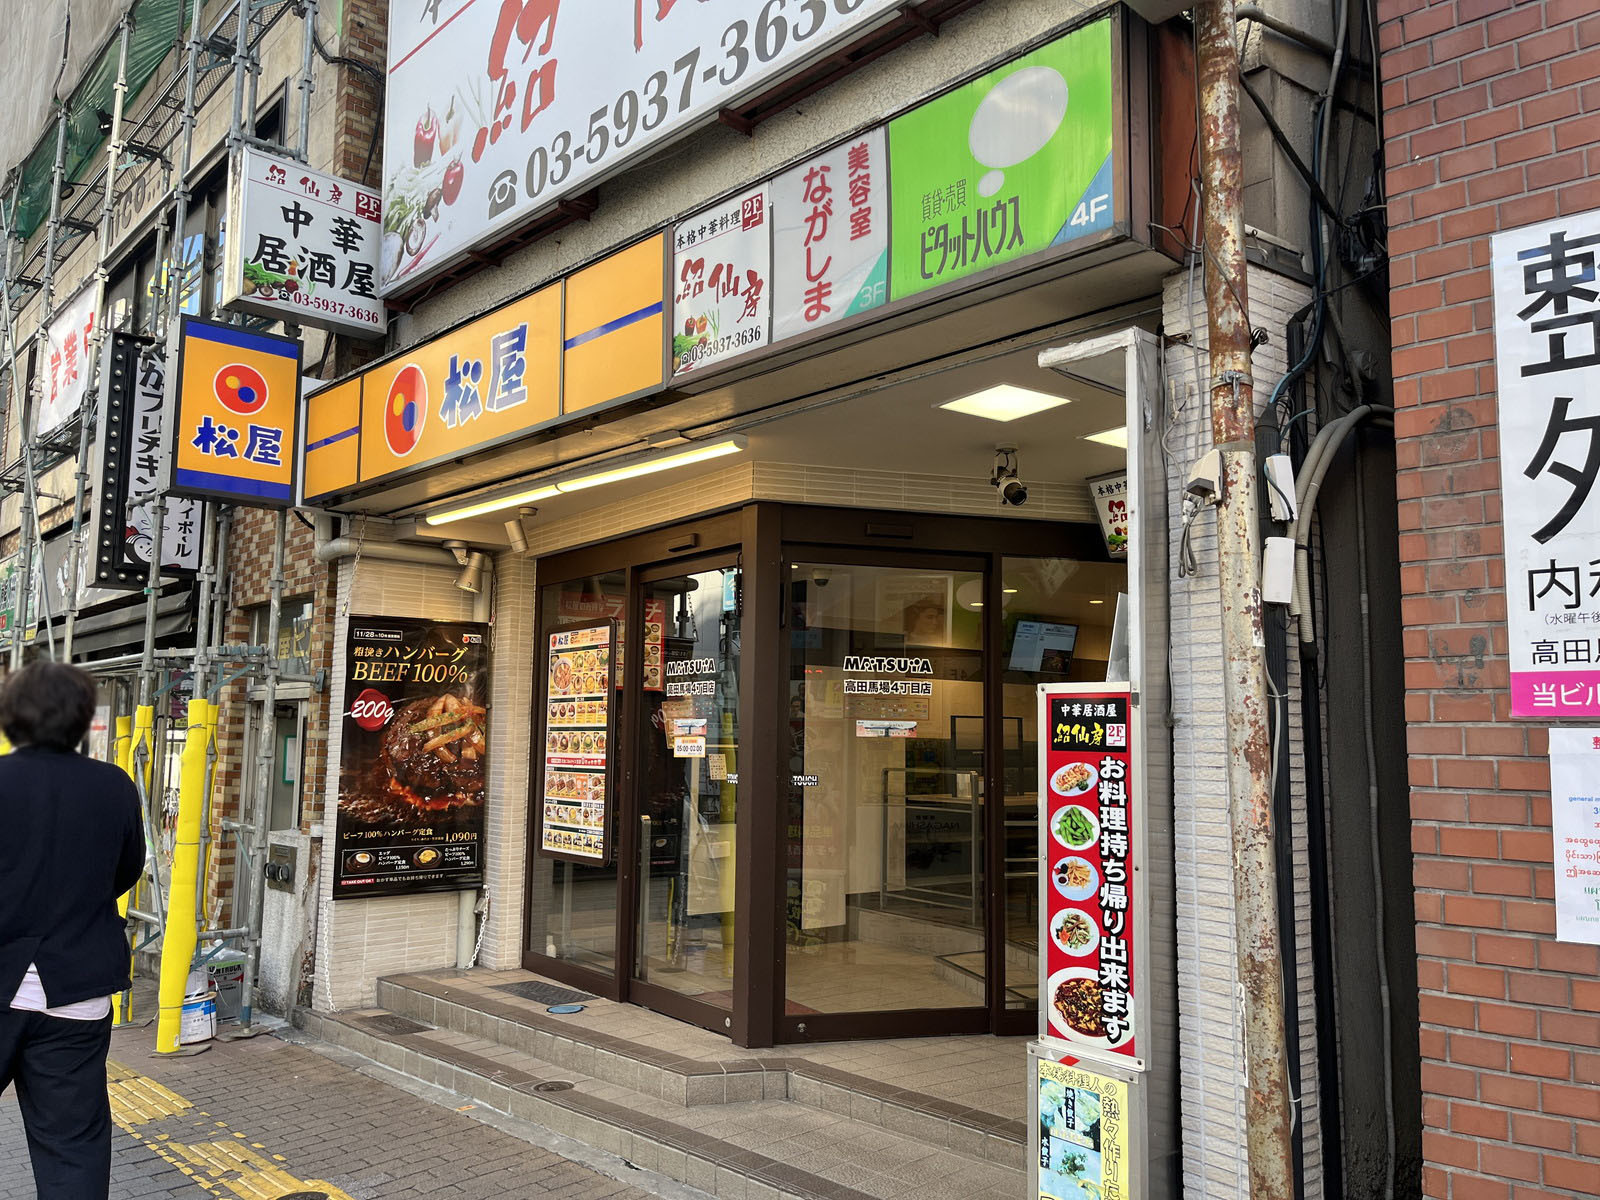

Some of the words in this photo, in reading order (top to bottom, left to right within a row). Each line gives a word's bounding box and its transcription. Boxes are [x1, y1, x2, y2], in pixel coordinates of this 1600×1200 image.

[525, 0, 864, 199] 03-5937-363
[358, 194, 382, 213] 2F
[743, 194, 764, 220] 2F
[847, 141, 872, 242] 美容室
[1069, 193, 1110, 227] 4F
[280, 200, 365, 255] 中華
[675, 208, 742, 250] 本格中華料理
[802, 165, 833, 323] ながしま
[920, 195, 1025, 280] ピタットハウス
[250, 233, 379, 301] 居酒屋
[292, 291, 380, 324] 03-5937-3636
[859, 280, 886, 308] 3F
[690, 325, 762, 364] 03-5937-3636
[438, 320, 530, 430] 松屋
[190, 415, 286, 468] 松屋
[354, 645, 469, 663] 粗挽きハンバーグ
[1530, 638, 1600, 666] 高田
[352, 661, 411, 682] BEEF
[411, 663, 468, 684] 100%
[843, 679, 933, 697] 高田馬場4丁目店
[351, 700, 395, 724] 200g
[1060, 703, 1118, 717] 中華居酒屋
[1107, 724, 1125, 738] 2F
[792, 775, 818, 786] TOUCH
[445, 831, 478, 844] 1,090円
[1097, 755, 1130, 1044] お料理持ち帰り出来ます
